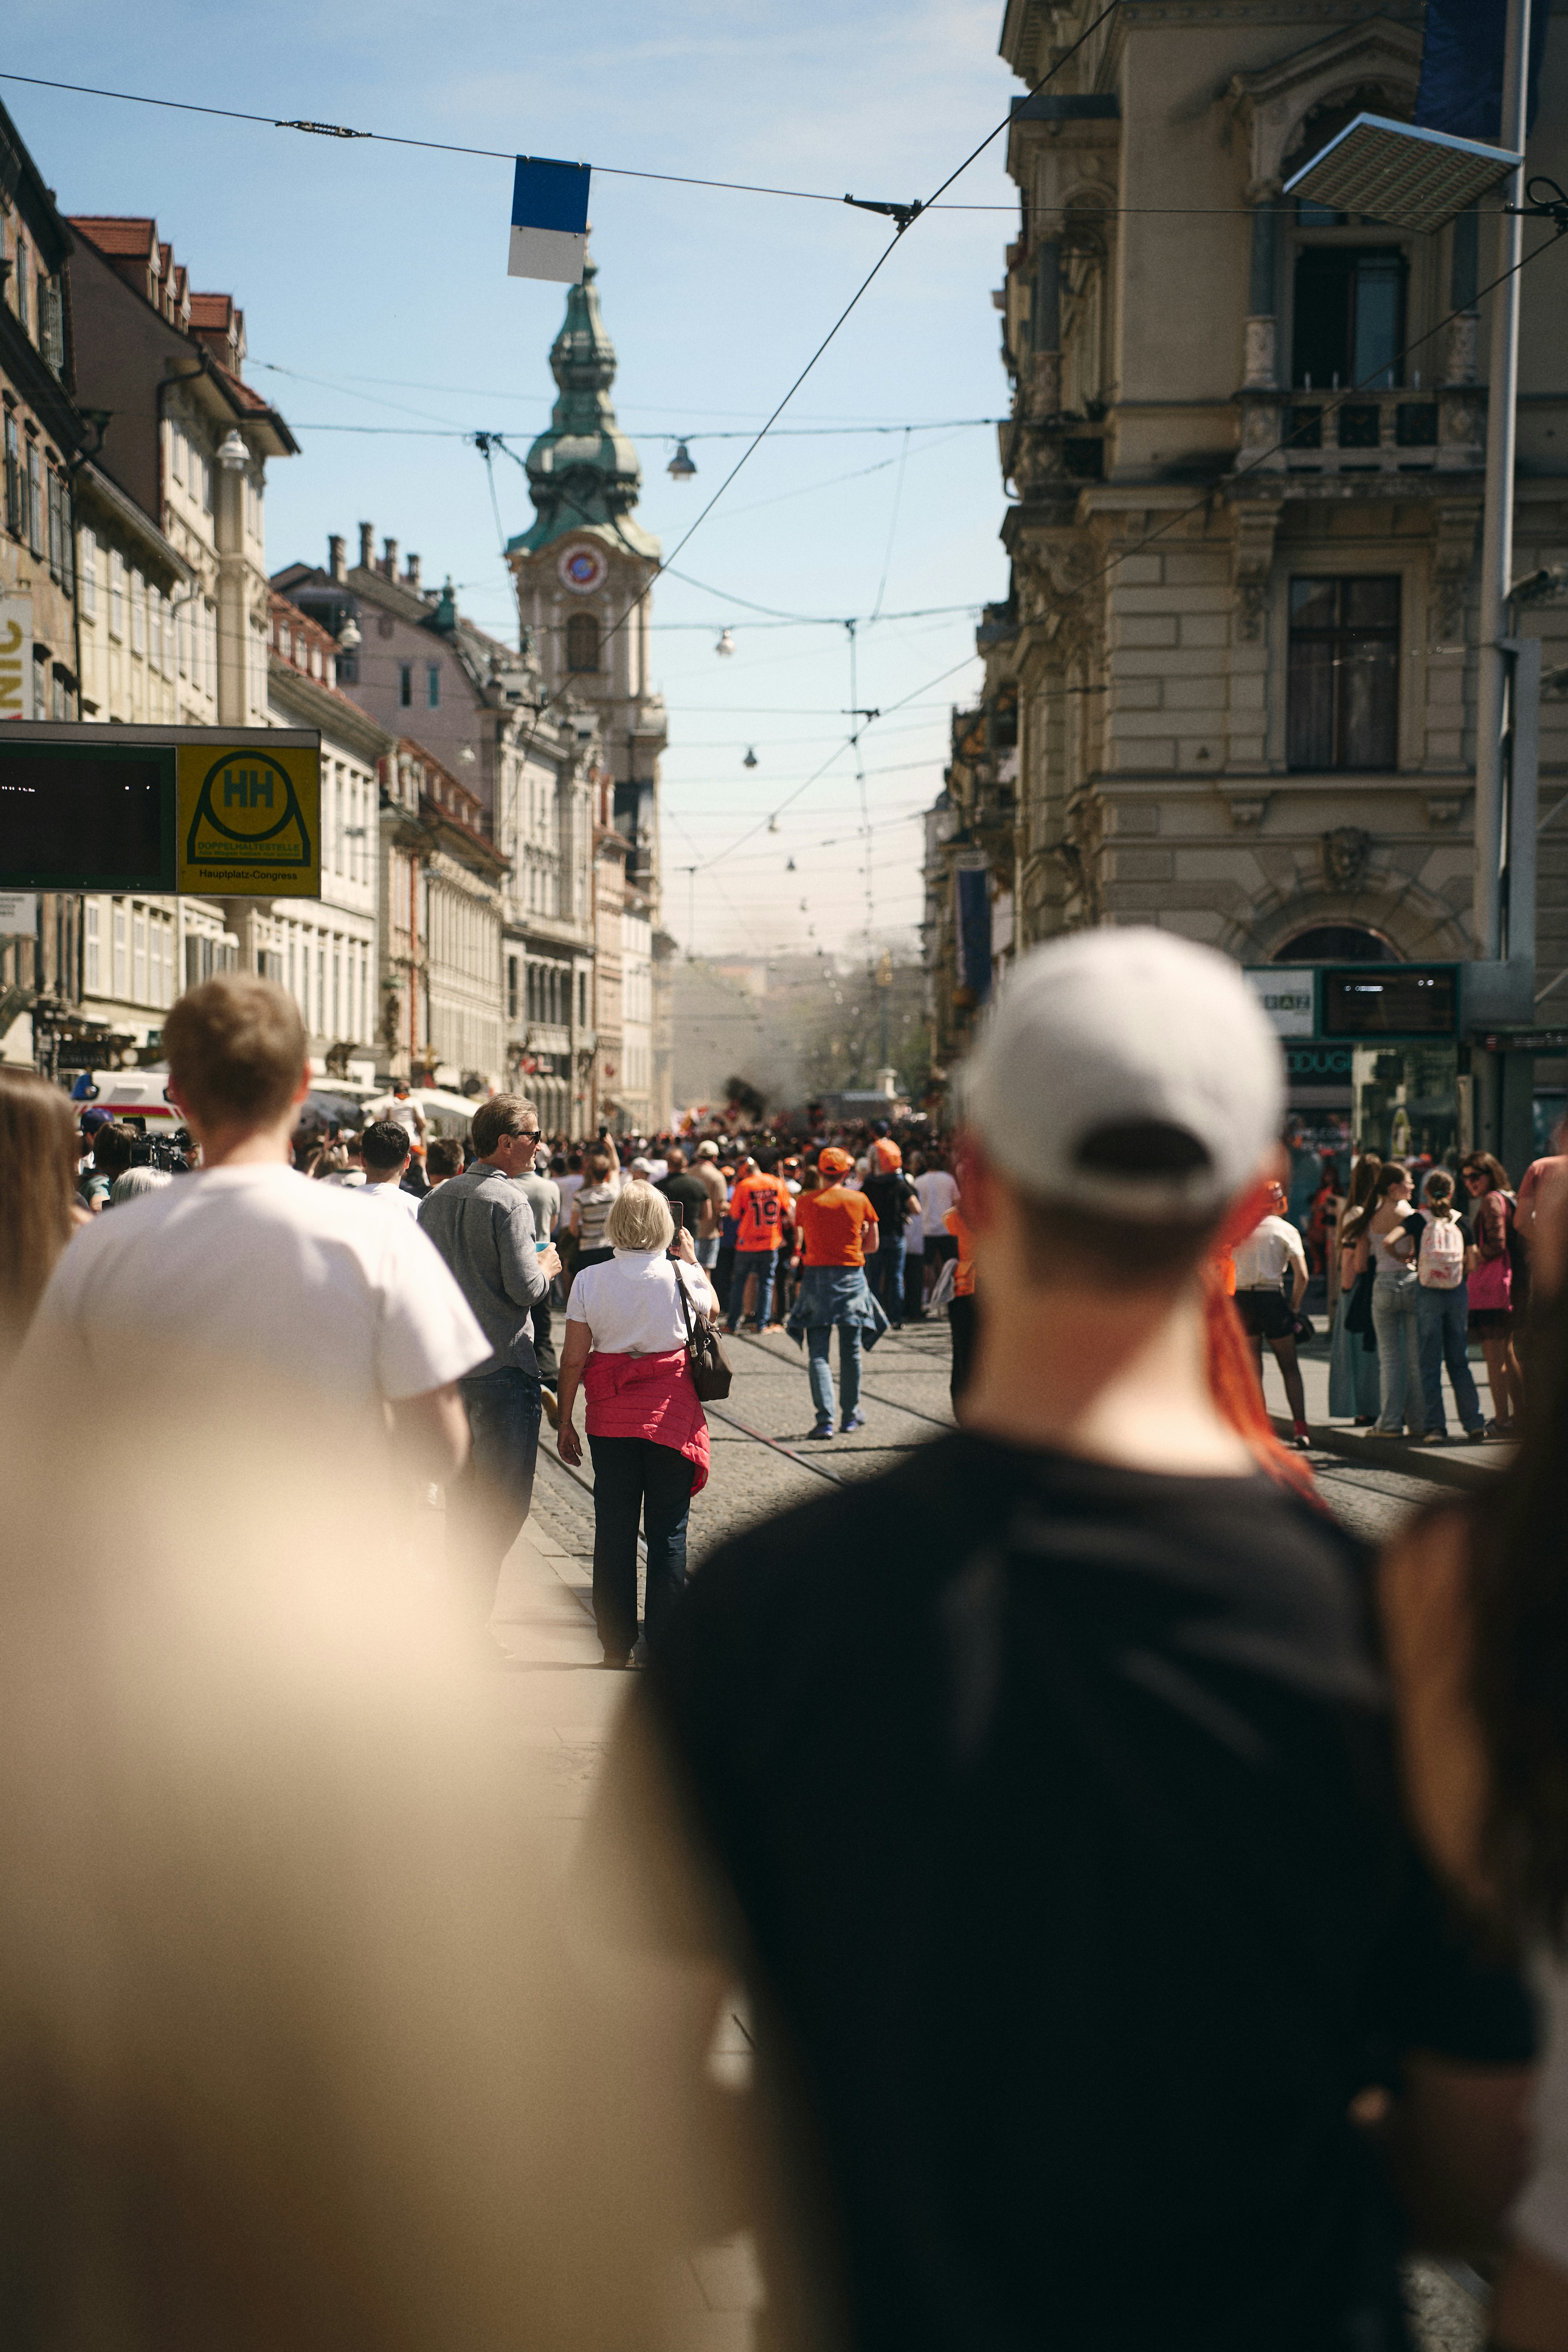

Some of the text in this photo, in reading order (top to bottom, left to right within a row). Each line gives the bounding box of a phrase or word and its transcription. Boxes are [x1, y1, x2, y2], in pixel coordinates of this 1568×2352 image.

[224, 769, 274, 808] HH
[198, 842, 300, 851] DOPPELHALTESTELLE
[199, 869, 297, 881] Hauptplatz-Congress
[751, 1200, 778, 1227] 19
